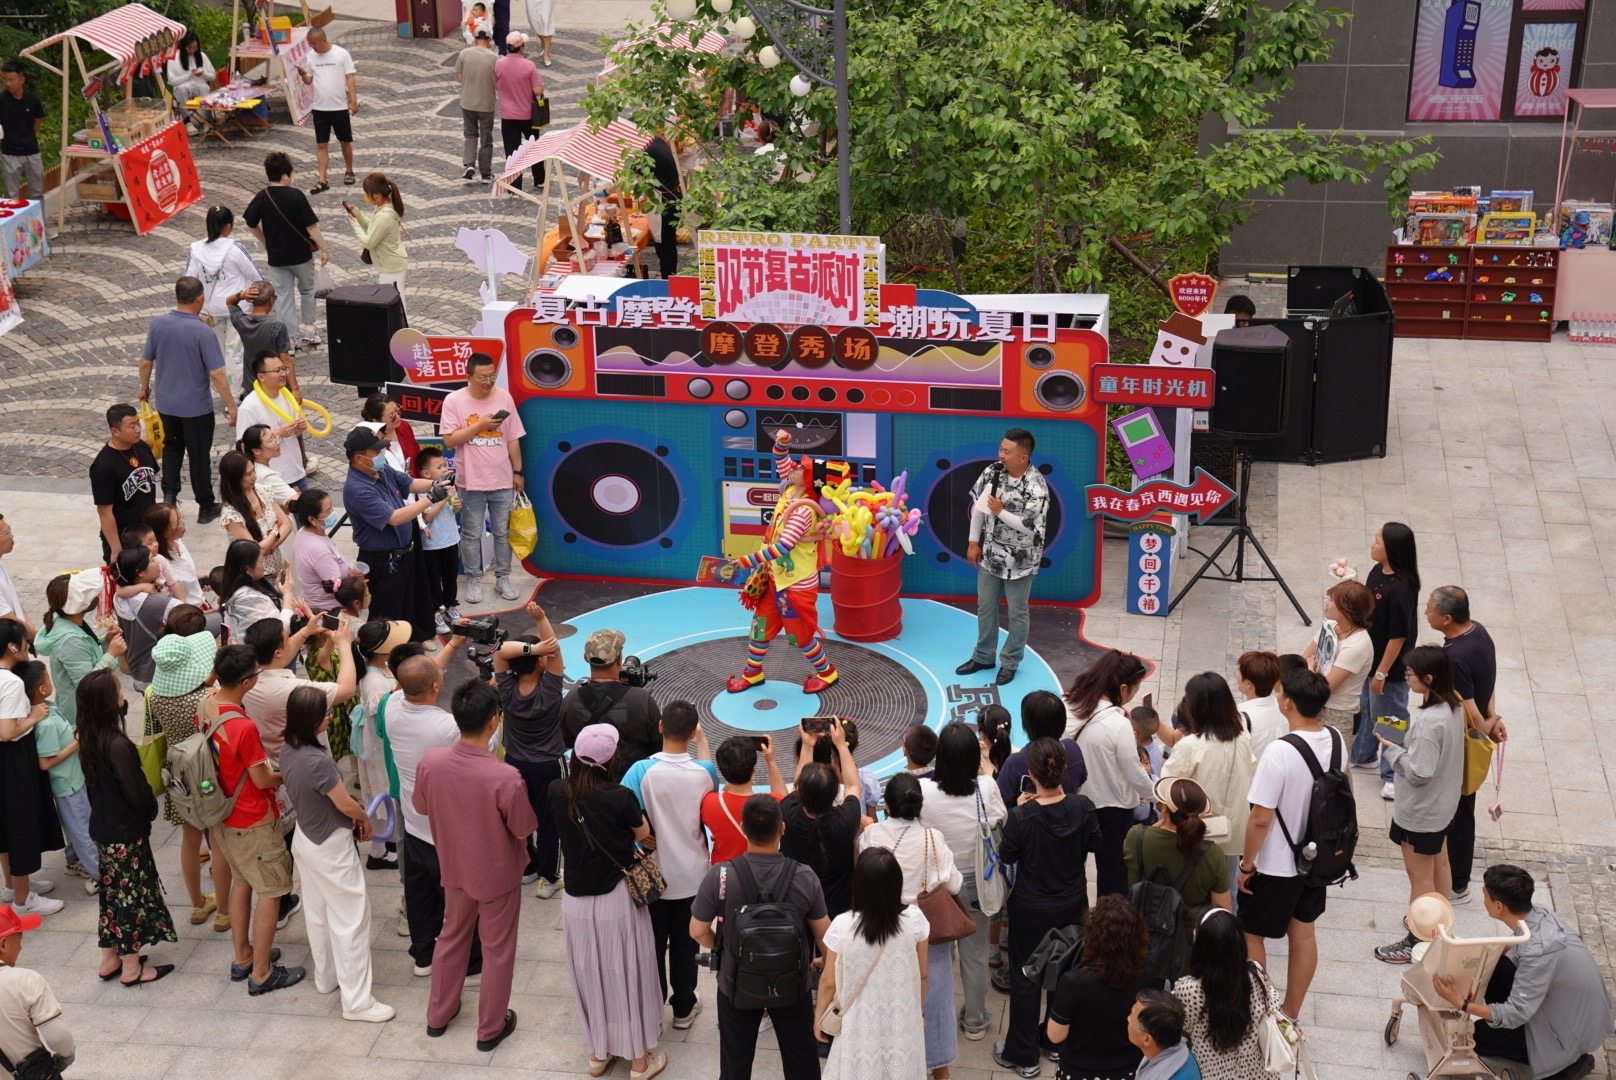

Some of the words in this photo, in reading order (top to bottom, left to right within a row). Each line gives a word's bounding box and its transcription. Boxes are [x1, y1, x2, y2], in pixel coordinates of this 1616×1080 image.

[1535, 25, 1566, 37] TIME
[1523, 39, 1575, 50] SQUARE
[698, 231, 783, 247] RETRO
[790, 234, 880, 250] PARTY
[699, 247, 716, 319] 摇摆之夏
[717, 248, 860, 321] 双节复古派对
[863, 253, 879, 326] 不要长大
[1178, 287, 1207, 295] 欢迎来到
[531, 291, 697, 330] 复古摩登
[887, 305, 1057, 344] 潮玩夏日
[412, 341, 473, 360] 赴一场
[709, 331, 871, 362] 摩登秀场
[1099, 375, 1208, 399] 童年时光机
[1092, 489, 1222, 512] 我在春京西遇见你
[1132, 523, 1154, 532] HAPPY
[1155, 524, 1173, 535] TIME
[1143, 538, 1157, 611] 梦回千禧
